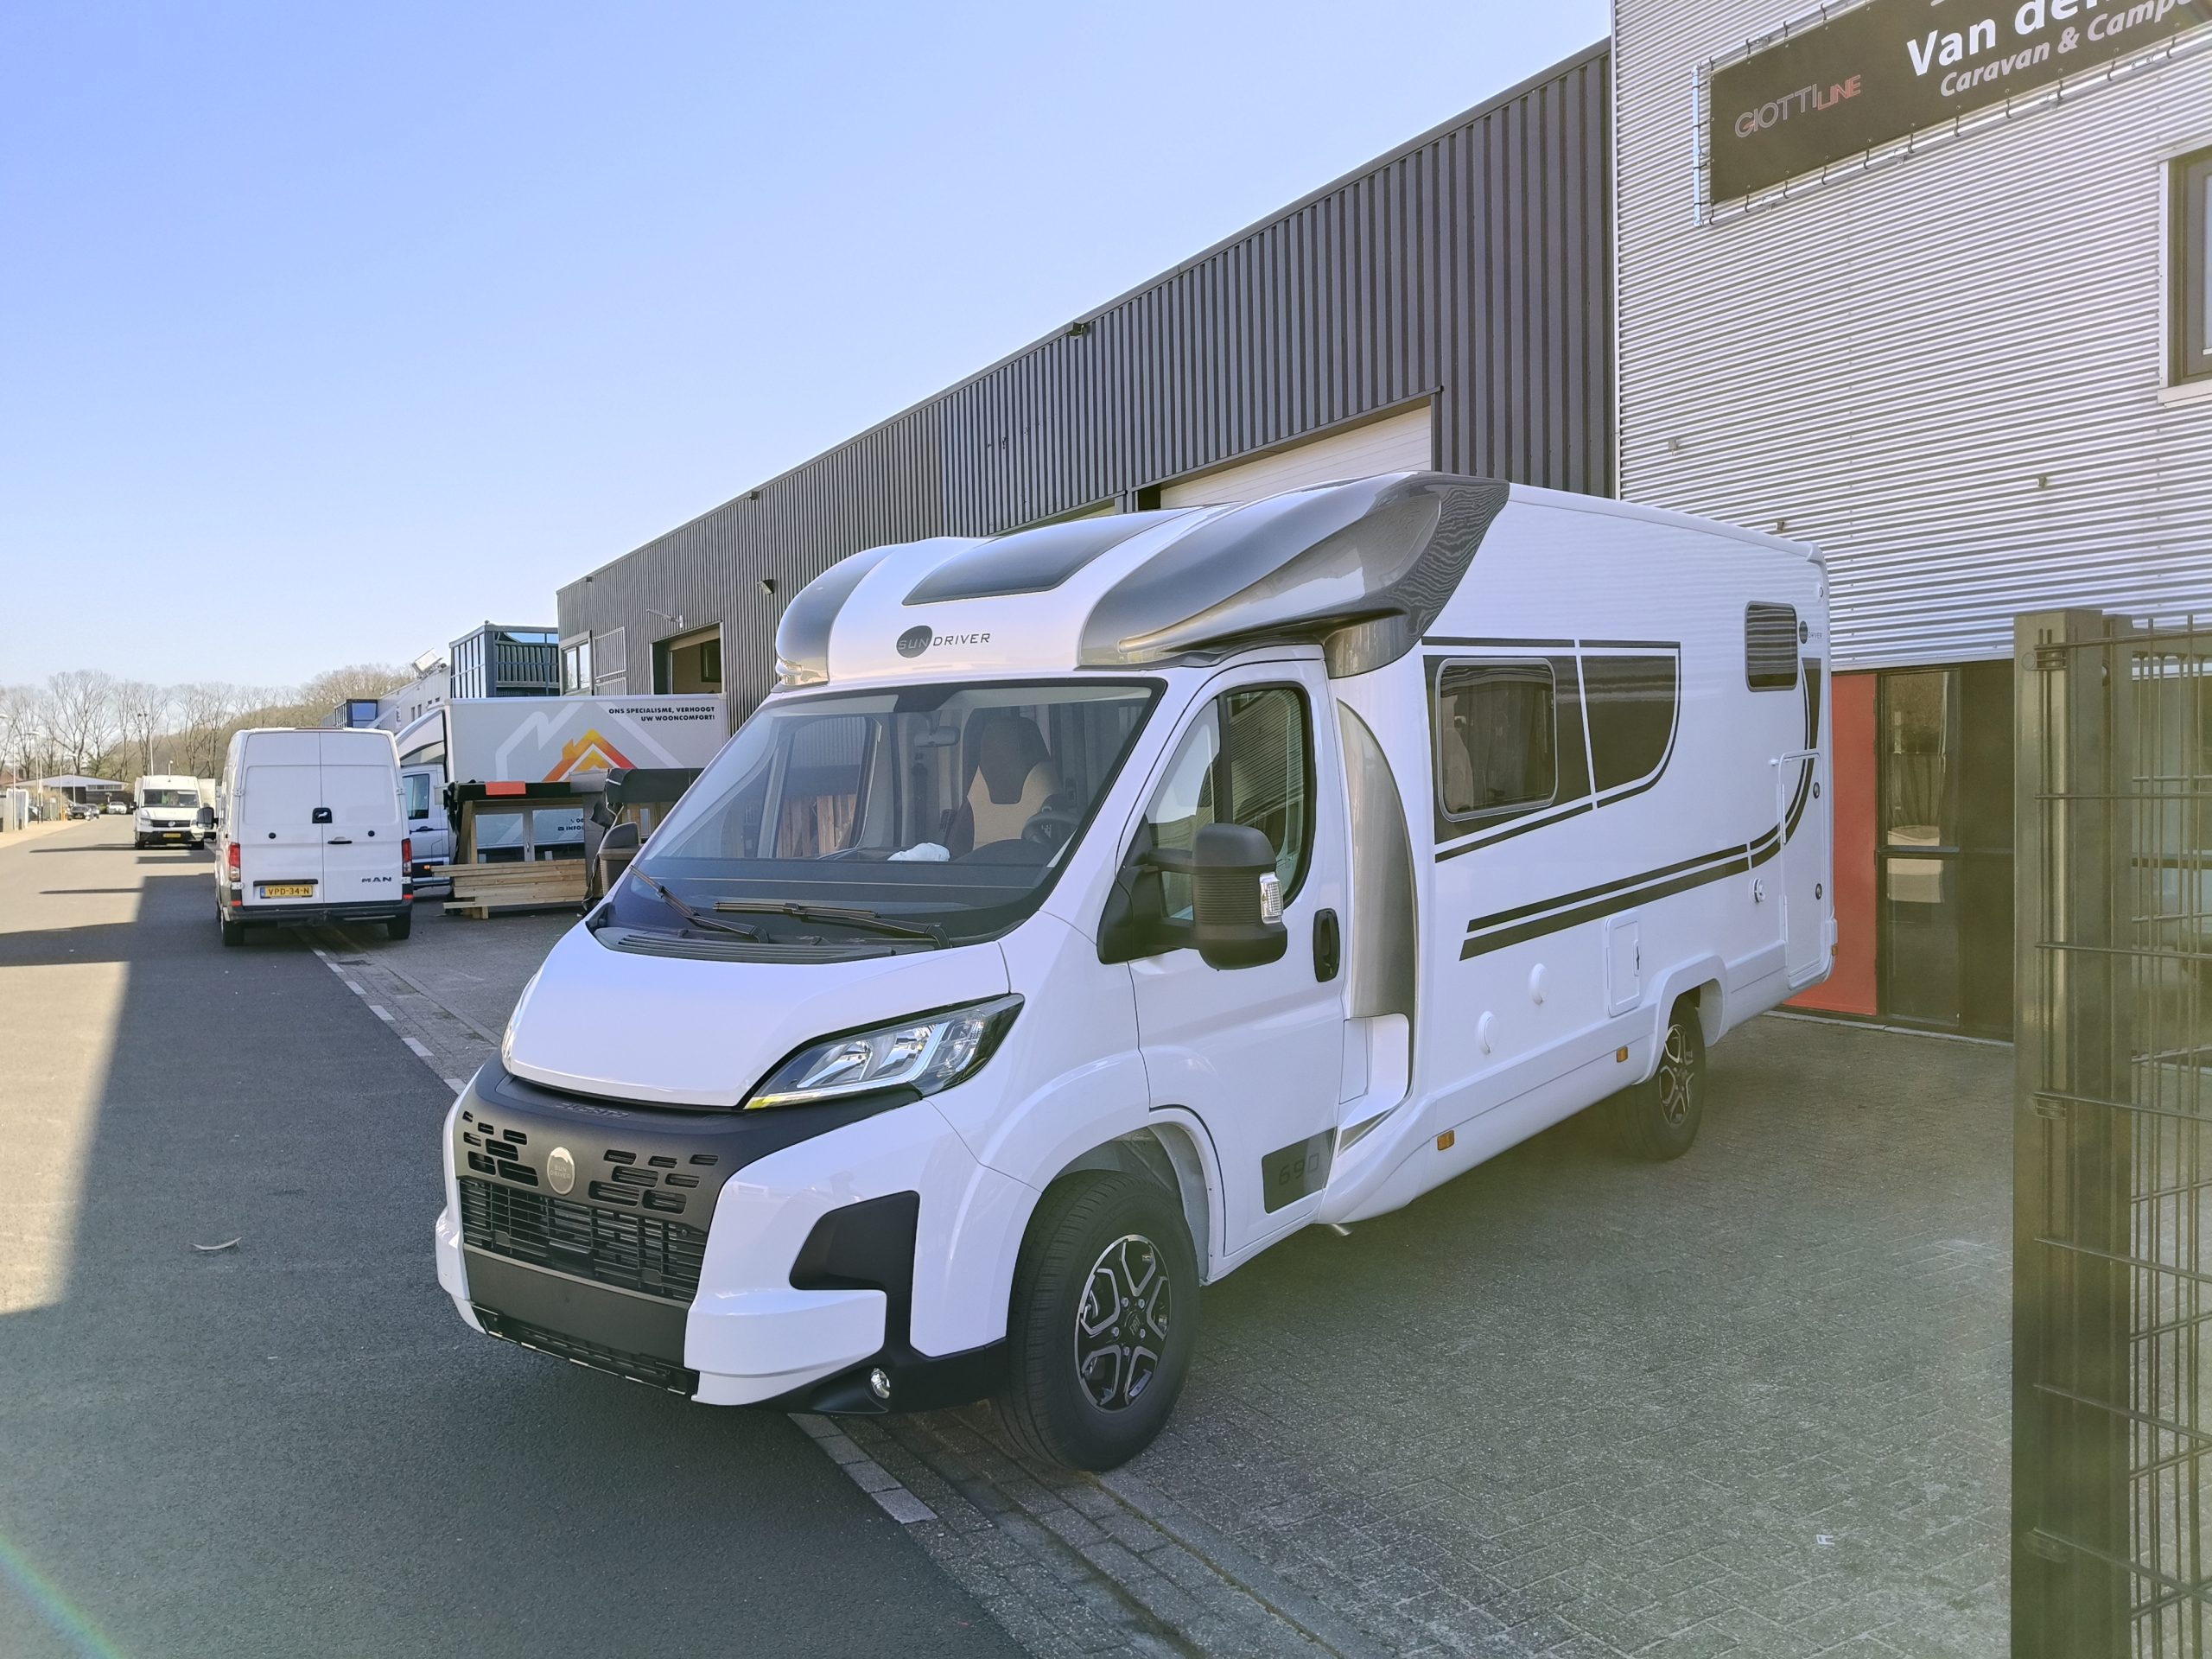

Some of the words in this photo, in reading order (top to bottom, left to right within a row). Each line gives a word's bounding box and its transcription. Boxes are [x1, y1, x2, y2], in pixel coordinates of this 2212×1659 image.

[1907, 18, 1997, 76] Van
[1940, 41, 2050, 97] Caravan
[2057, 26, 2081, 54] &
[2087, 0, 2192, 41] Camp
[933, 632, 990, 646] DRIVER
[268, 886, 310, 896] VPD-34-N
[1280, 1152, 1319, 1186] 690
